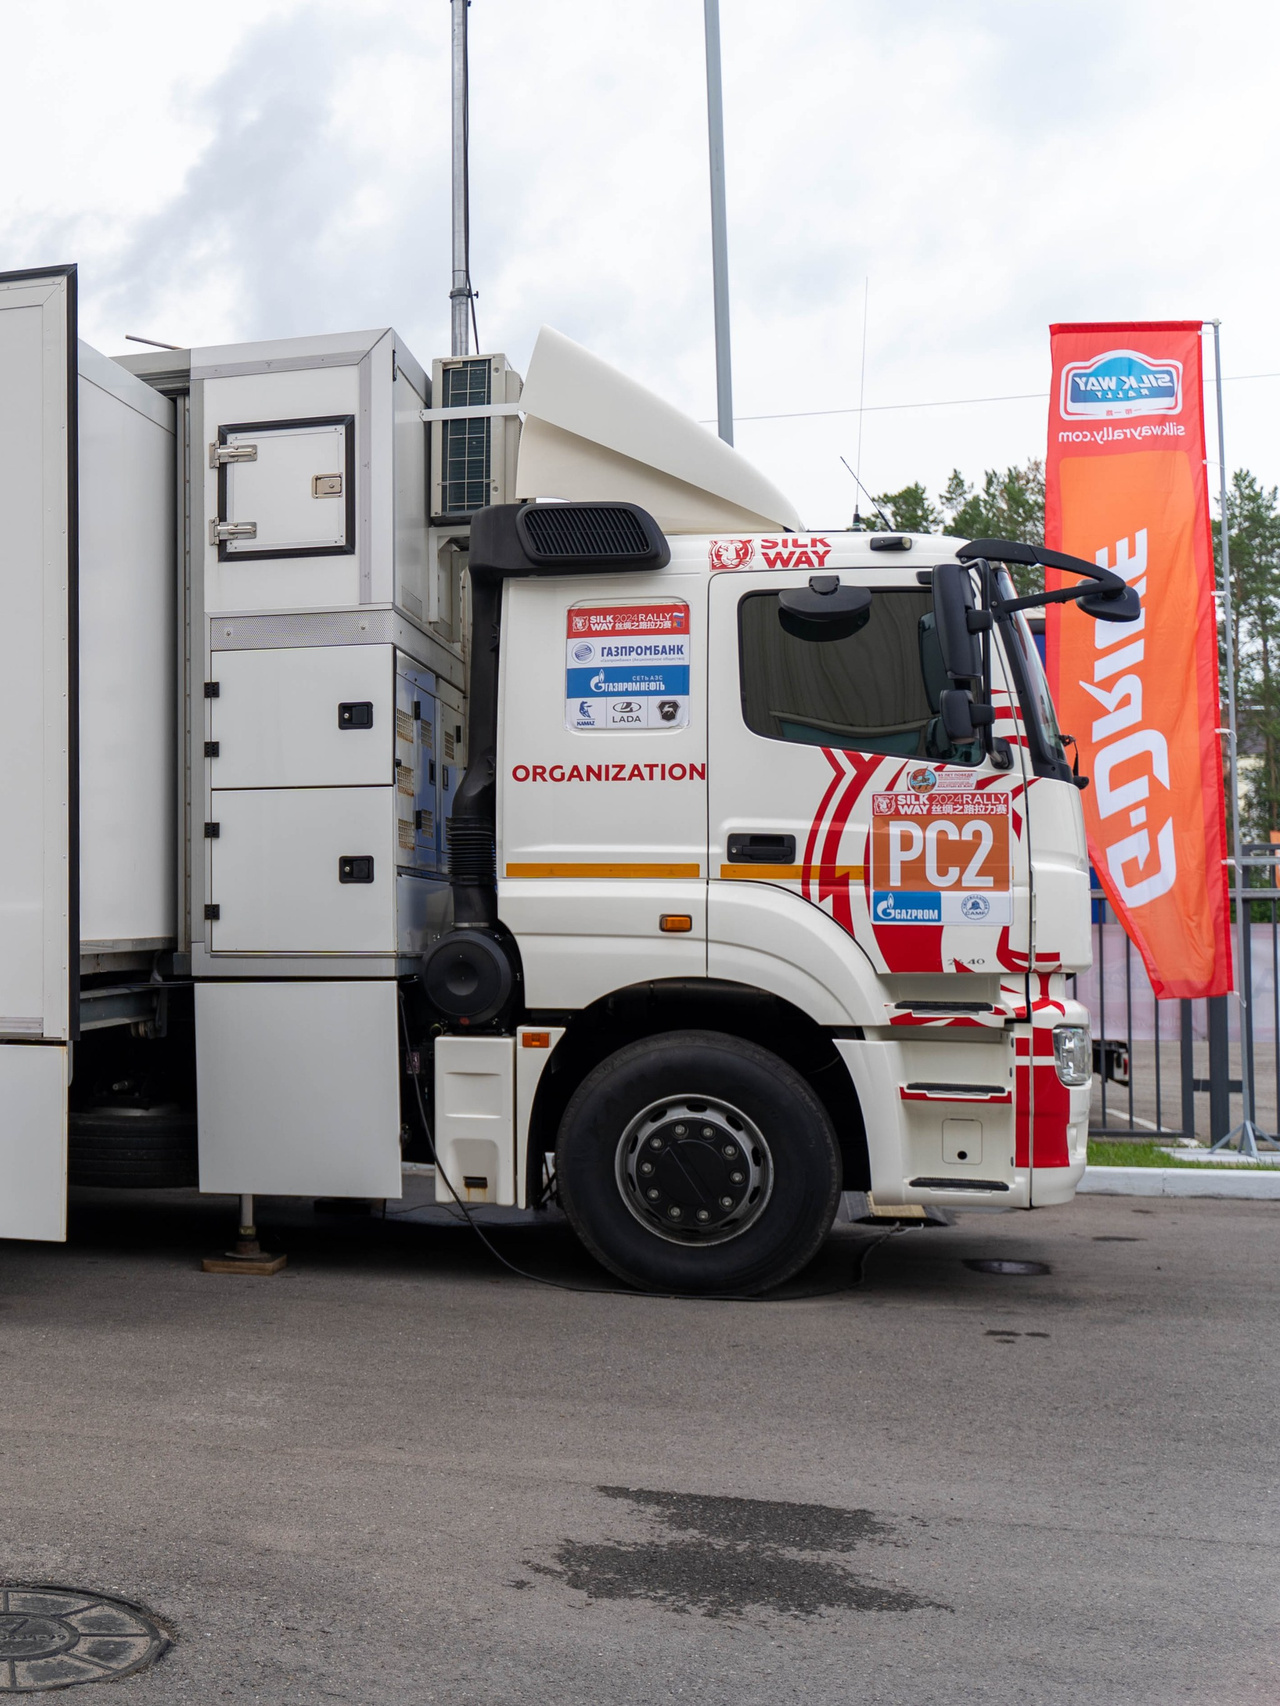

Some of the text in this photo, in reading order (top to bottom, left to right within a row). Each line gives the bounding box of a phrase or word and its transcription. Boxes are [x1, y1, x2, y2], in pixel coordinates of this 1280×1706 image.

[761, 537, 832, 549] SILK
[761, 550, 832, 569] WAY
[590, 614, 614, 624] SILK
[590, 623, 613, 631] WAY
[601, 644, 684, 657] ГАЗПРОМБАНК
[604, 681, 665, 692] ГАЗПРОМНЕФТЬ
[612, 715, 642, 723] LADA
[511, 763, 706, 782] ORGANIZATION
[897, 795, 929, 804] SILK
[898, 804, 1007, 815] WAY 丝绸之路拉力赛
[889, 820, 993, 887] PC2
[895, 909, 939, 920] GAZPROM
